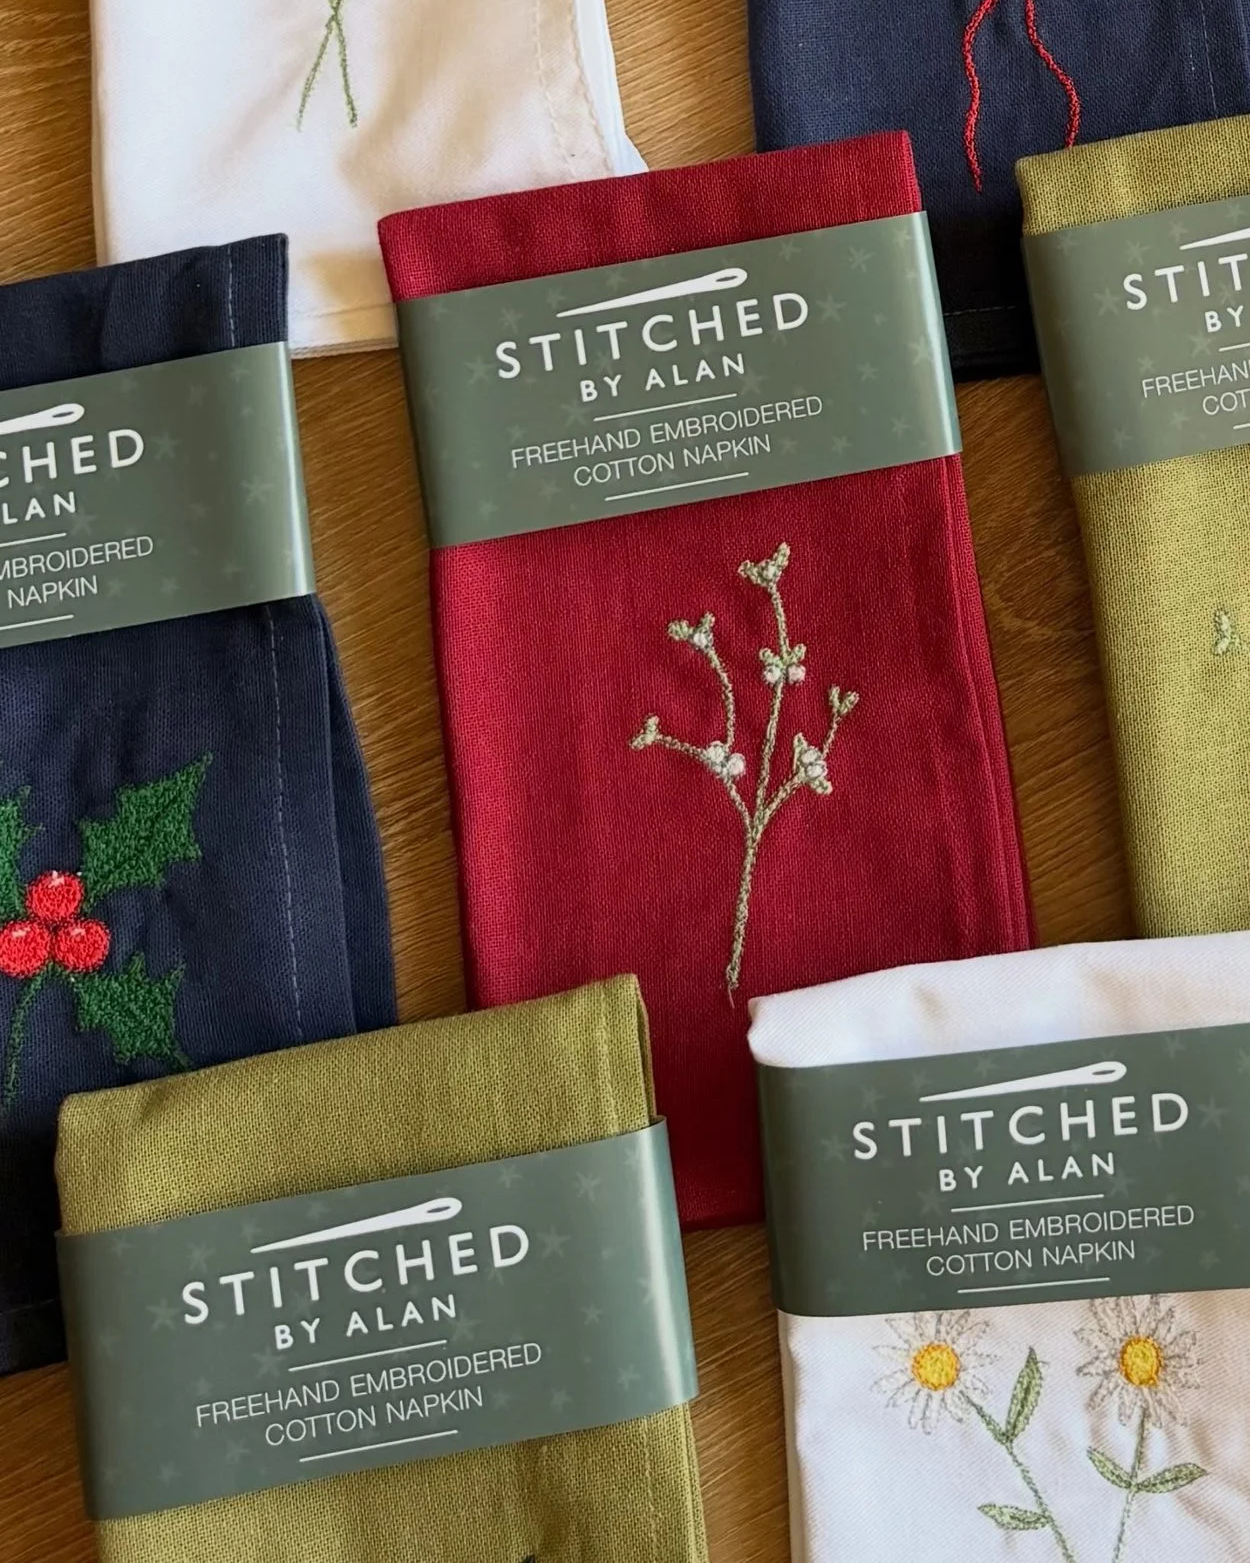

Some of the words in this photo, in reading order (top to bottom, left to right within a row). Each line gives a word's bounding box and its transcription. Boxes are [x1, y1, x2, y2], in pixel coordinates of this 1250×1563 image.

[495, 293, 809, 379] STITCHED
[1204, 305, 1244, 333] BY
[580, 374, 622, 402] BY
[645, 353, 745, 391] ALAN
[511, 428, 641, 469] FREEHAND
[650, 396, 823, 444] EMBROIDERED
[573, 451, 675, 487] COTTON
[683, 433, 771, 467] NAPKIN
[7, 575, 98, 609] NAPKIN
[852, 1093, 1189, 1160] STITCHED
[939, 1165, 983, 1192] BY
[1007, 1151, 1114, 1185] ALAN
[862, 1222, 999, 1251] FREEHAND
[1009, 1205, 1194, 1240] EMBROIDERED
[182, 1225, 529, 1325] STITCHED
[926, 1248, 1032, 1276] COTTON
[1042, 1239, 1135, 1267] NAPKIN
[274, 1317, 320, 1350] BY
[346, 1294, 456, 1337] ALAN
[196, 1380, 340, 1428] FREEHAND
[350, 1342, 542, 1397] EMBROIDERED
[265, 1405, 376, 1446] COTTON
[386, 1385, 483, 1424] NAPKIN
